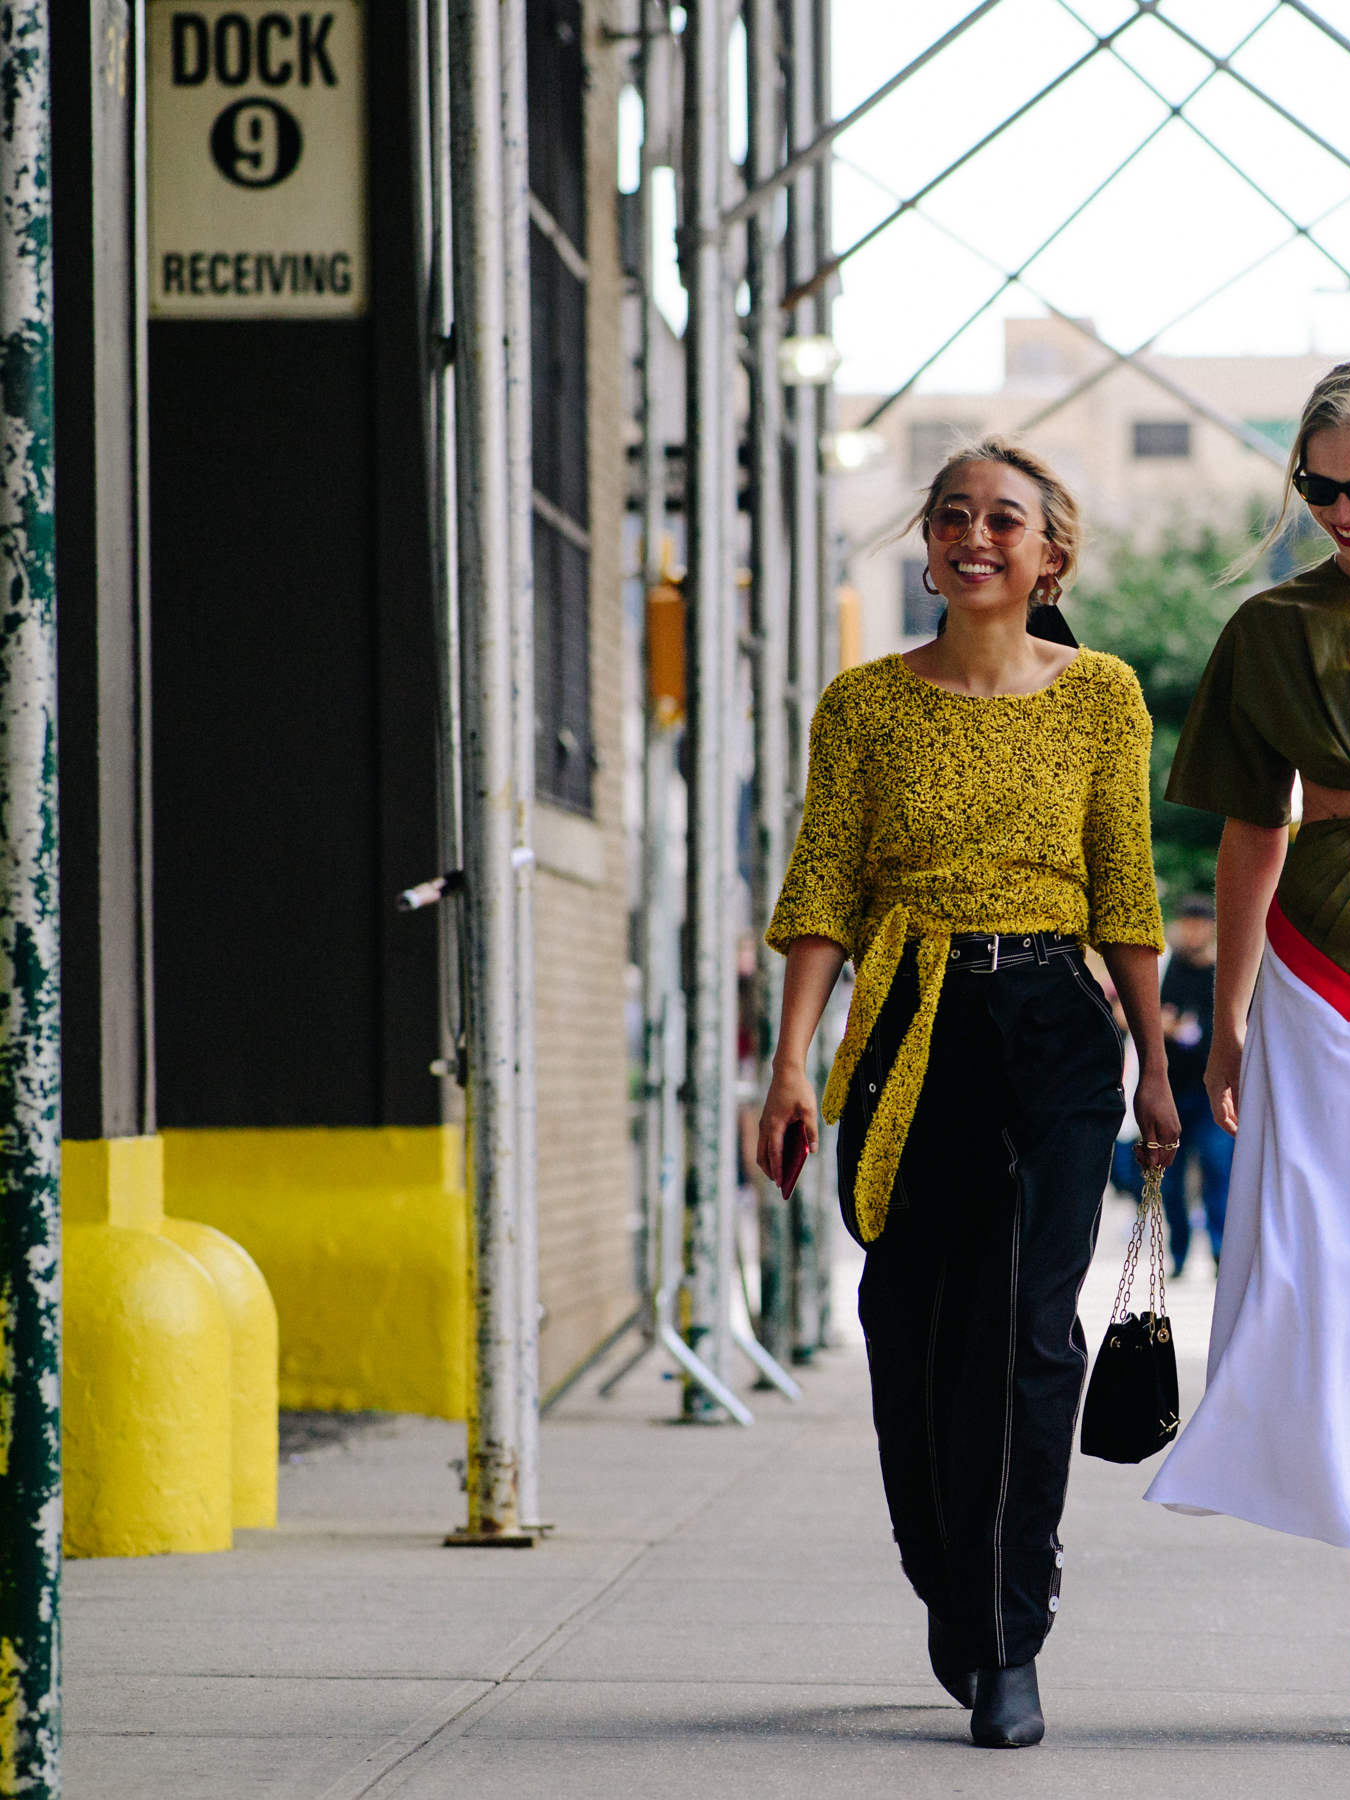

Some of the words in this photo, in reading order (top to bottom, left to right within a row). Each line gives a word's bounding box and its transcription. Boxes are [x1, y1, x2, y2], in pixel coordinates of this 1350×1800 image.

[171, 12, 337, 88] DOCK
[232, 106, 280, 183] 9
[162, 252, 351, 296] RECEIVING
